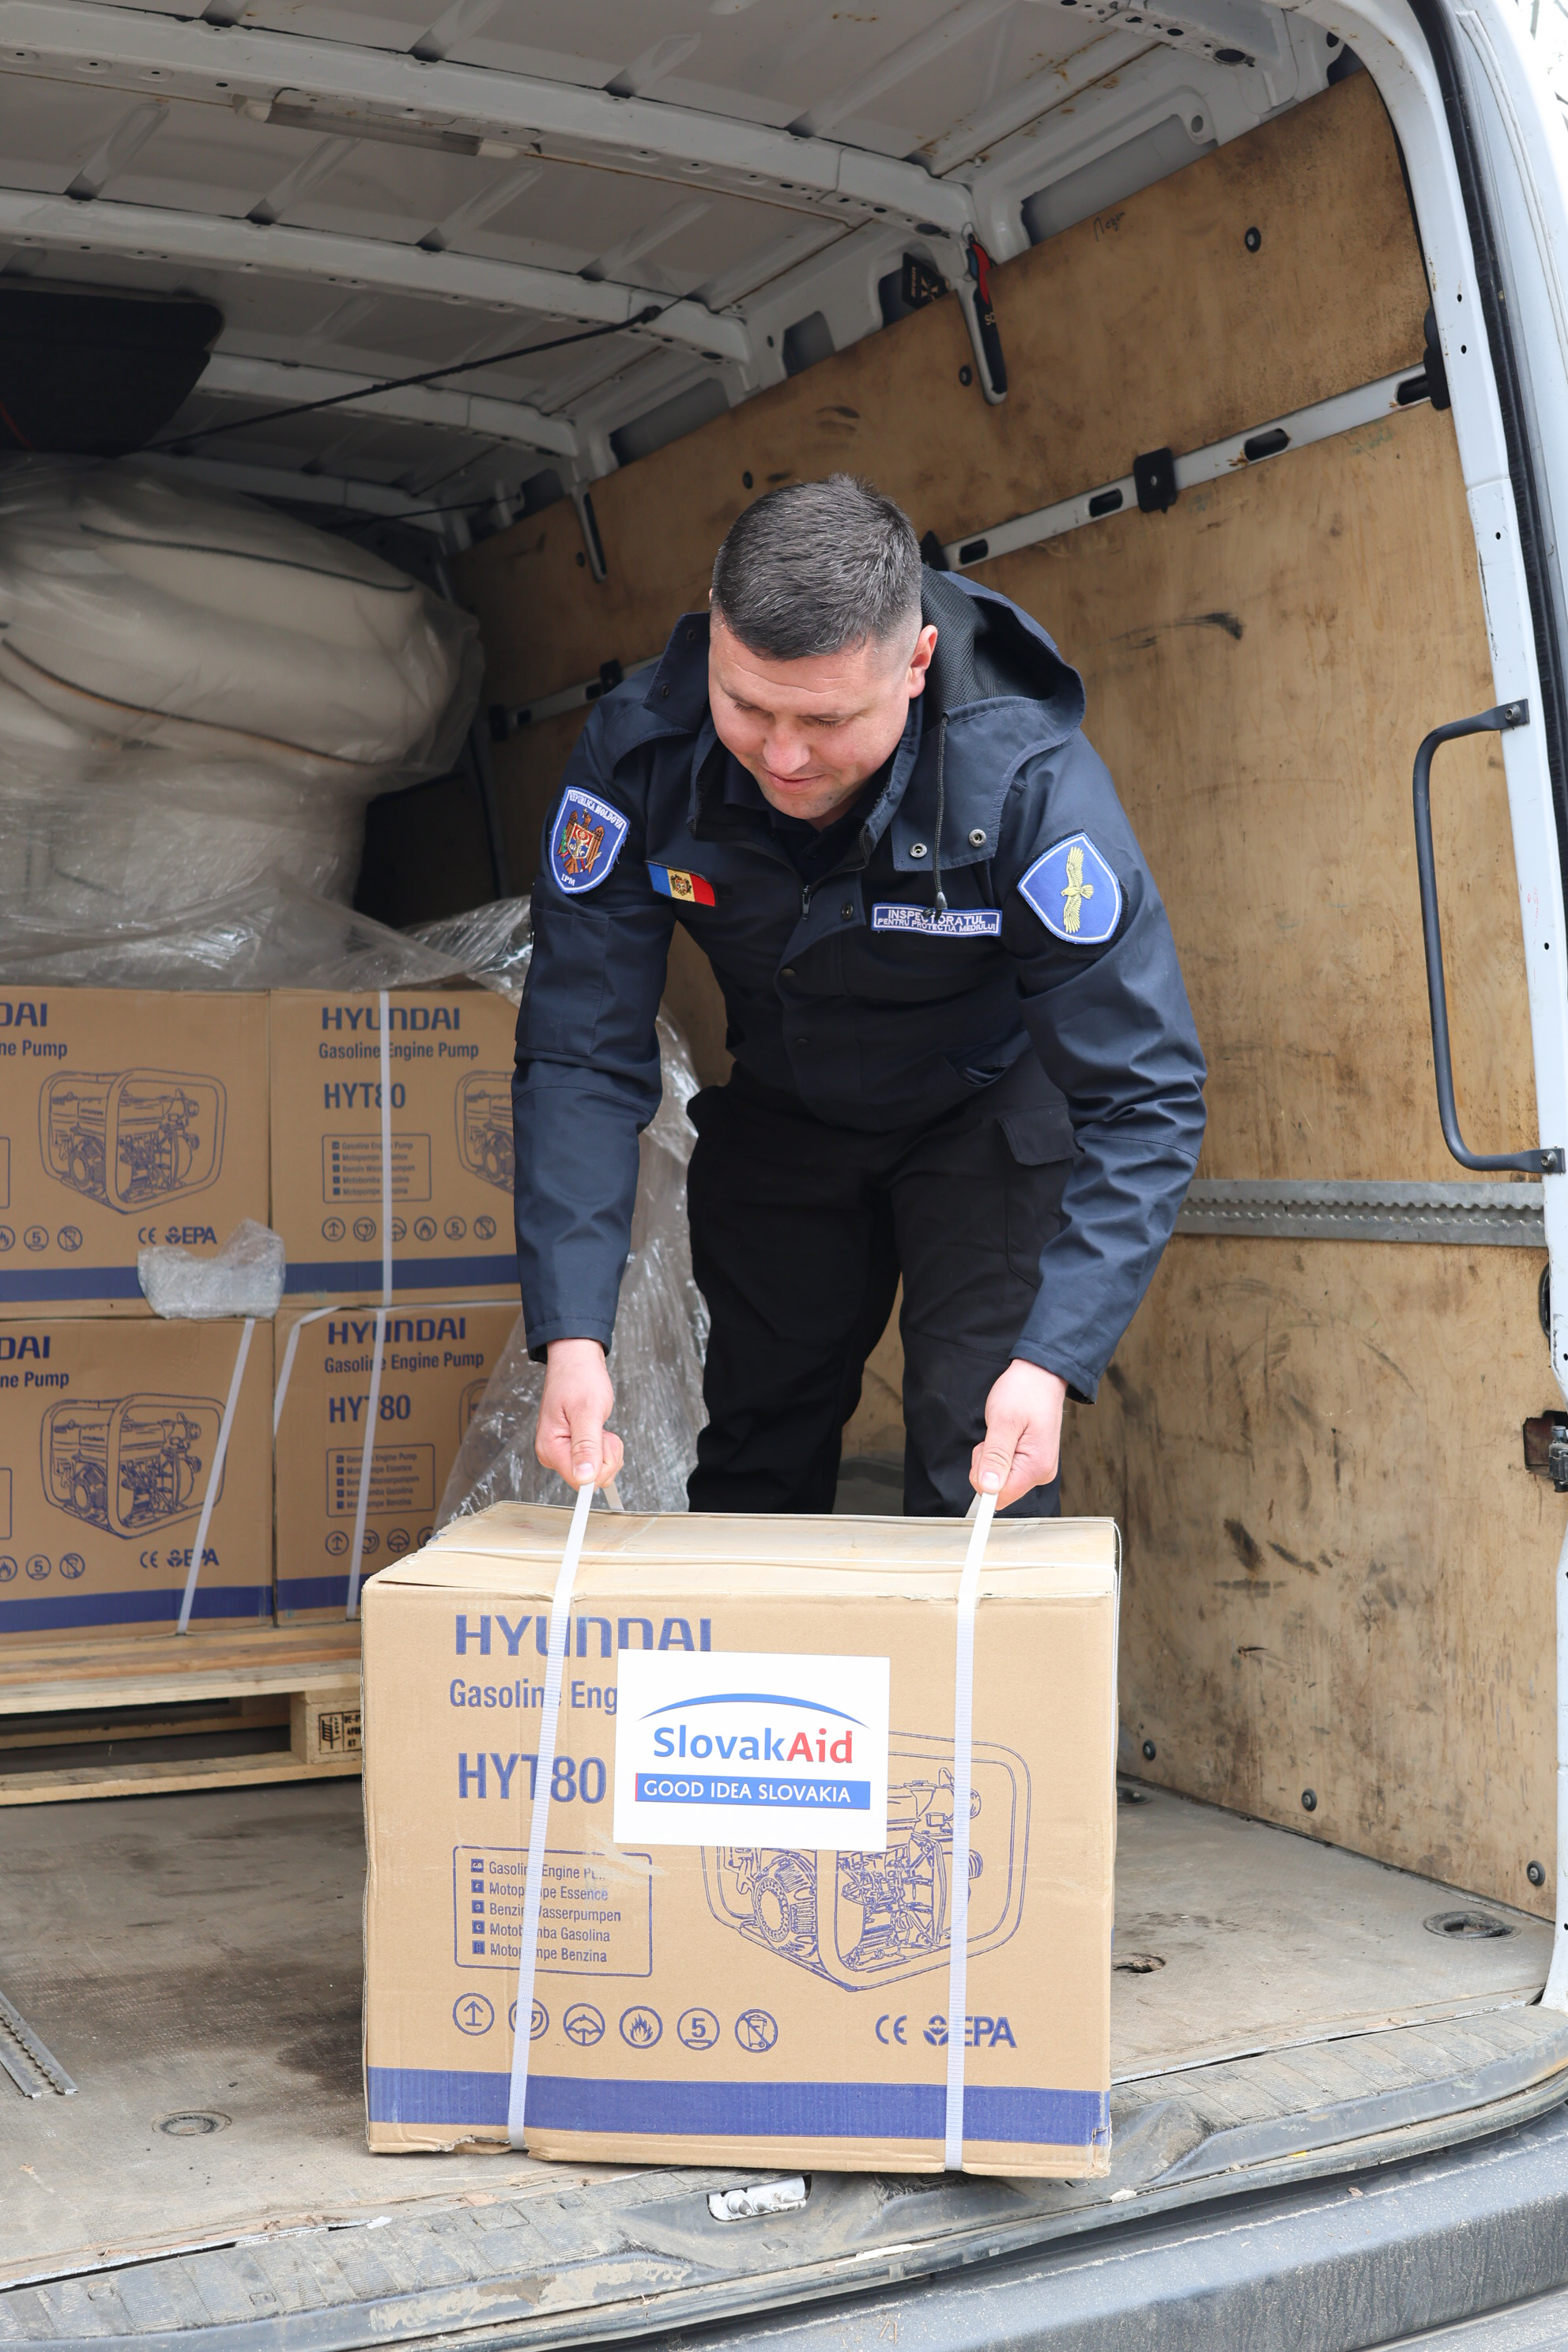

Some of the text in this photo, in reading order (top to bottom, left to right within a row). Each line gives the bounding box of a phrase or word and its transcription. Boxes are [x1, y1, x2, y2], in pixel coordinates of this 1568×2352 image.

[594, 805, 624, 830] MOLDOVA
[877, 918, 910, 926] PENTRU
[959, 923, 996, 933] MEDIULUI
[22, 1039, 68, 1061] Pump
[318, 1042, 380, 1059] Gasoline
[439, 1042, 479, 1061] Pump
[32, 1231, 40, 1243] 5
[138, 1227, 217, 1245] CE EPA
[451, 1222, 459, 1234] 5
[391, 1352, 439, 1373] Engine
[444, 1351, 484, 1369] Pump
[24, 1370, 70, 1389] Pump
[34, 1560, 43, 1573] 5
[140, 1551, 158, 1569] CE
[450, 1678, 618, 1715] Gasolin Eng
[654, 1724, 853, 1763] SlovakAid
[643, 1780, 851, 1804] GOOD IDEA SLOVAKIA
[542, 1864, 580, 1881] Engine
[489, 1882, 556, 1900] Motoppe
[560, 1885, 608, 1901] Essence
[539, 1905, 621, 1924] asserpumpen
[560, 1927, 610, 1942] Gasolina
[561, 1947, 607, 1962] Benzina
[691, 2017, 706, 2037] 5
[875, 2014, 907, 2045] CE
